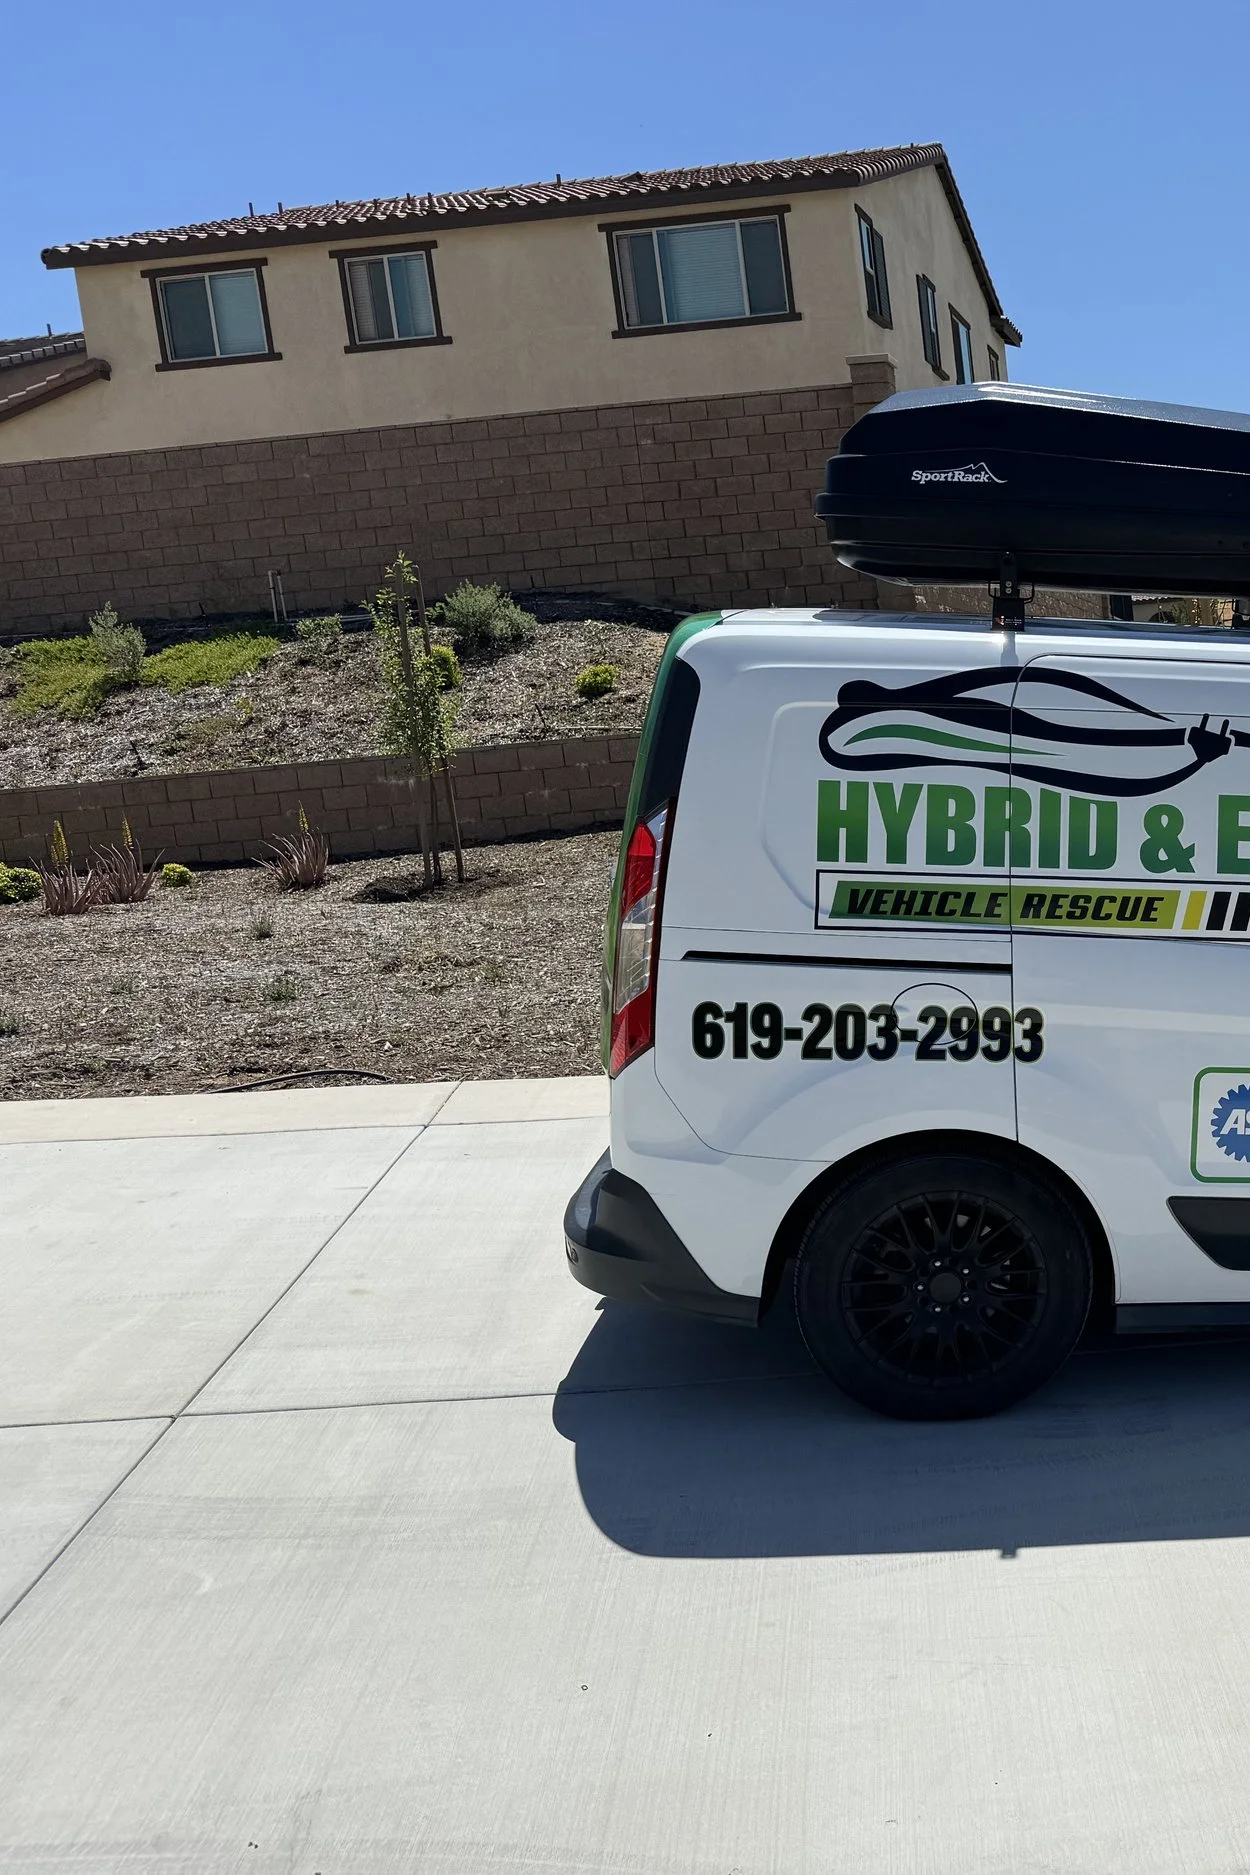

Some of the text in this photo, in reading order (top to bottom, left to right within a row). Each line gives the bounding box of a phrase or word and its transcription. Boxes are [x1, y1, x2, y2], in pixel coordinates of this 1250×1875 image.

[911, 469, 989, 484] SportRack
[816, 780, 1118, 870] HYBRID
[1139, 804, 1196, 874] &
[846, 889, 1165, 922] VEHICLE RESCUE
[691, 1001, 1044, 1063] 619-203-2993
